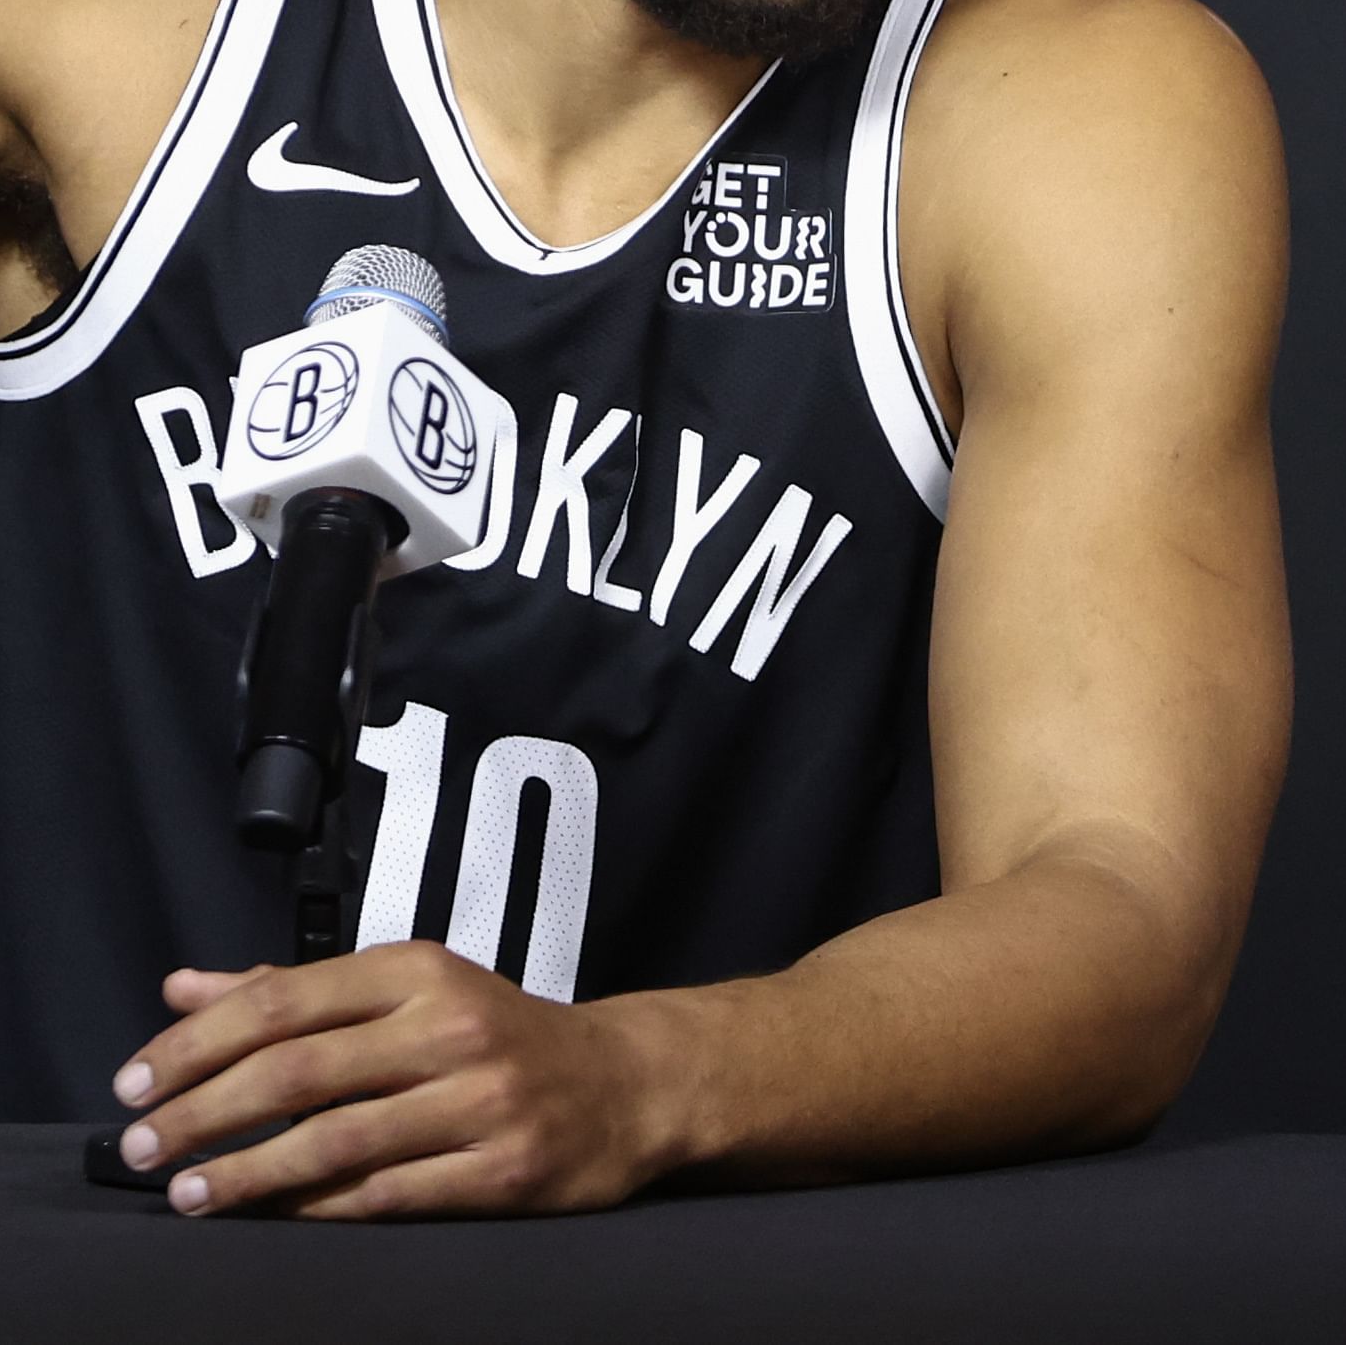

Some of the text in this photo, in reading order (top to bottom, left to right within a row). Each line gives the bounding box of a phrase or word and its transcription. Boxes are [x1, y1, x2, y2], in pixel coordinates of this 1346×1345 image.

[683, 210, 826, 260] YOUR
[666, 257, 830, 308] GUIDE
[283, 361, 322, 444] B
[415, 379, 450, 470] B
[355, 701, 598, 1004] 10
